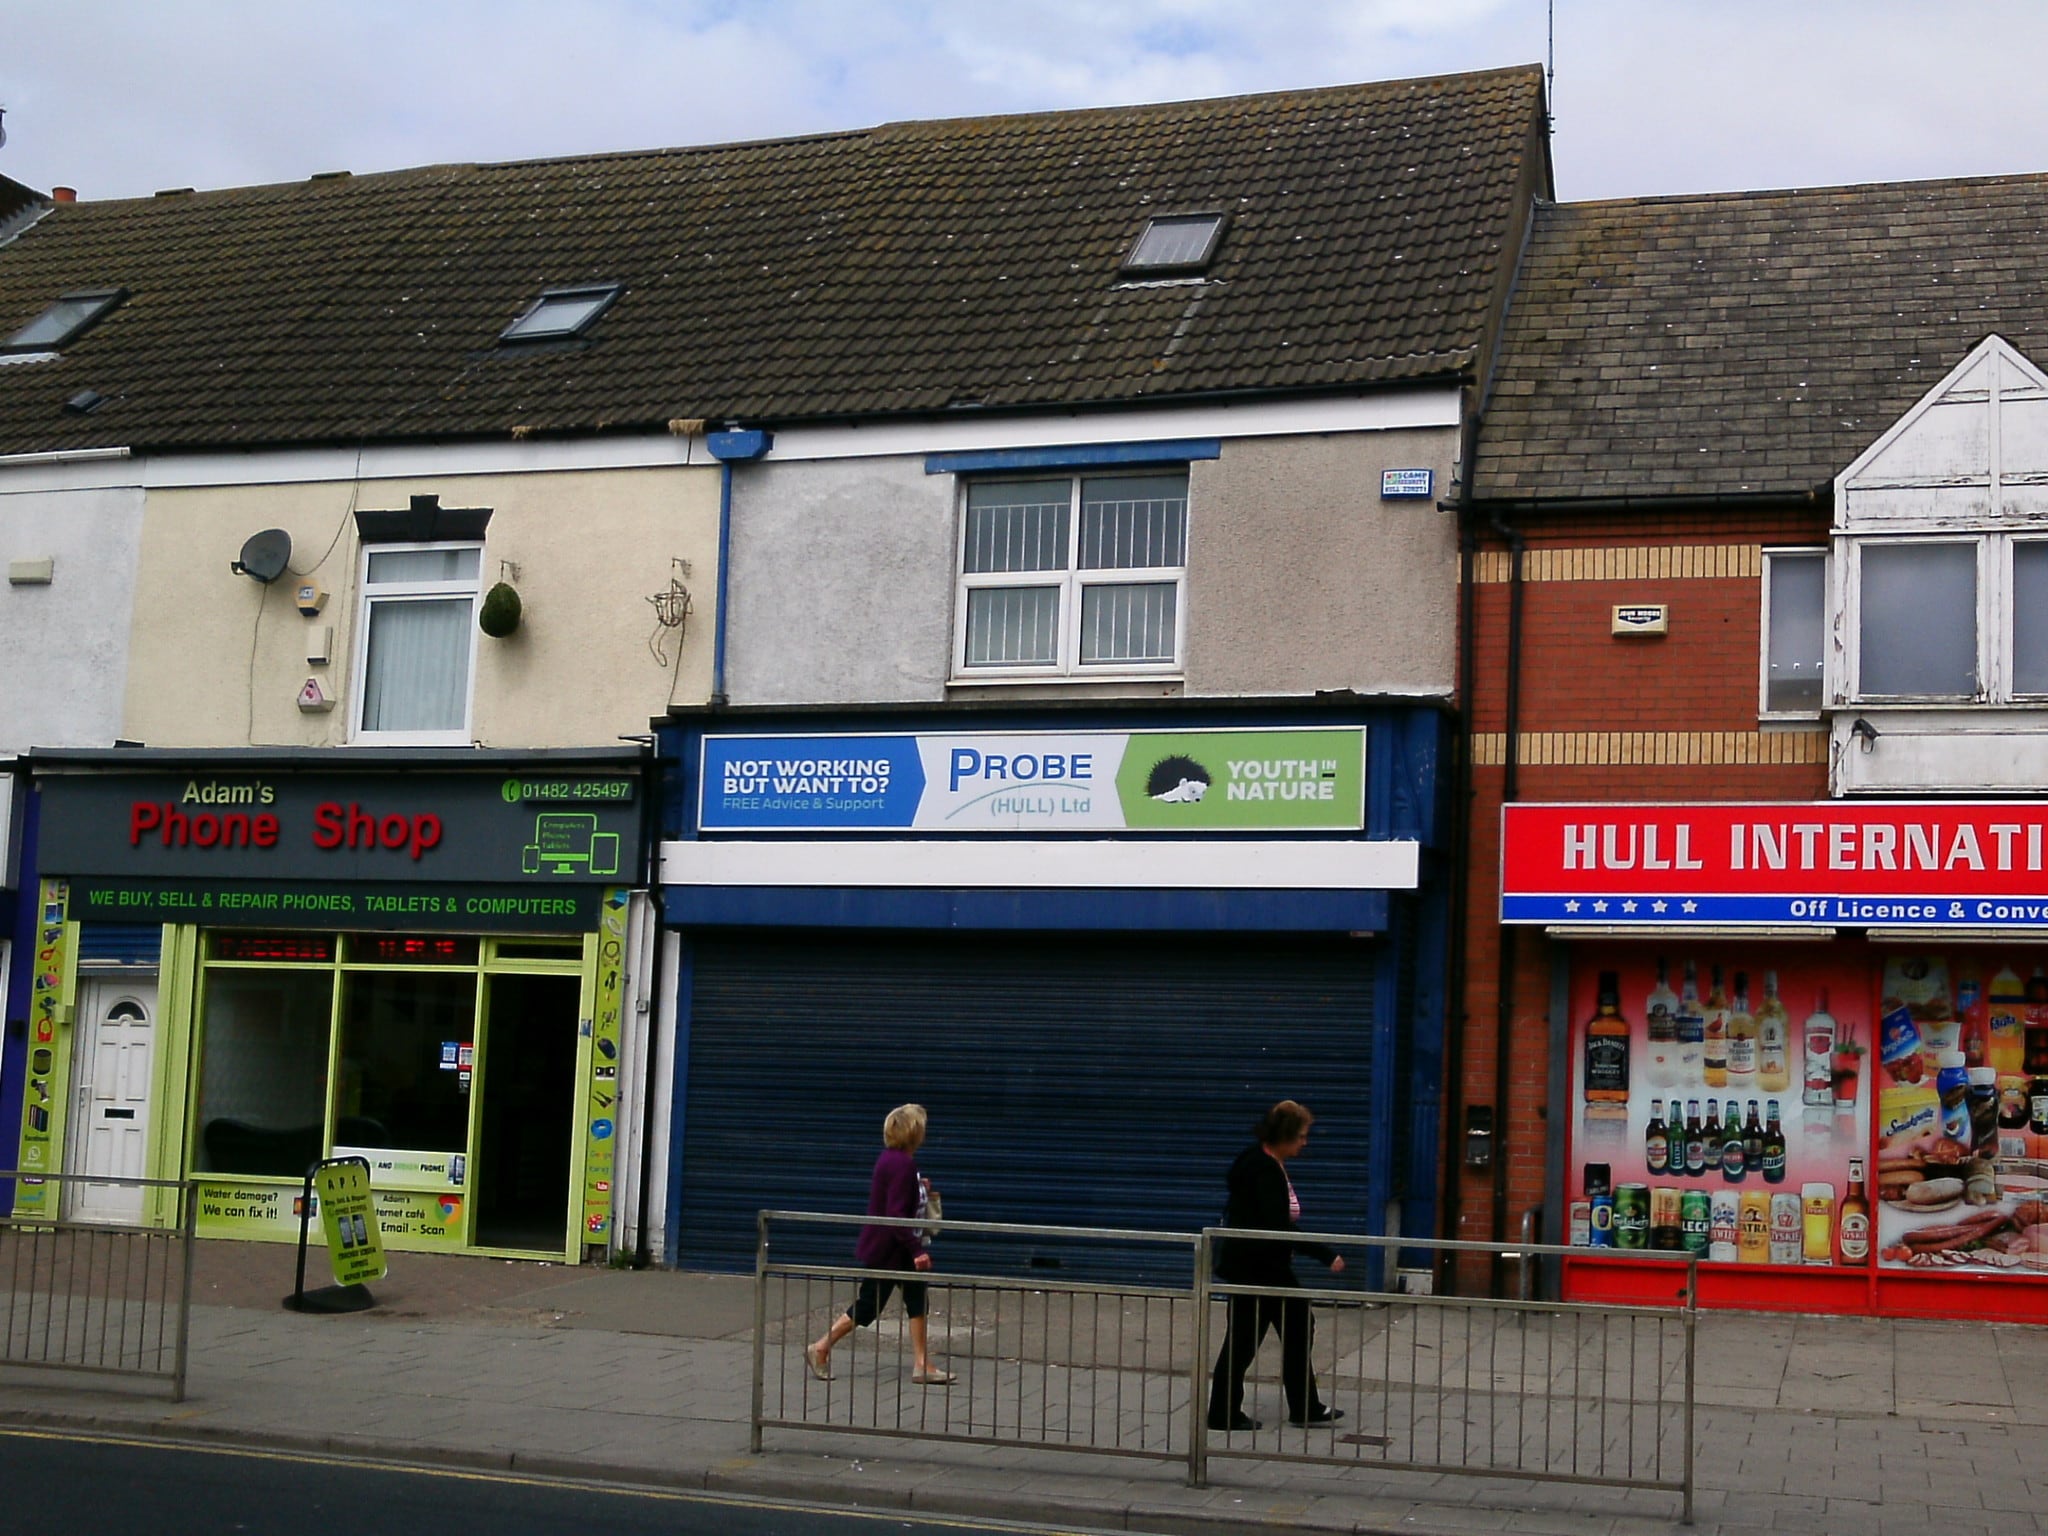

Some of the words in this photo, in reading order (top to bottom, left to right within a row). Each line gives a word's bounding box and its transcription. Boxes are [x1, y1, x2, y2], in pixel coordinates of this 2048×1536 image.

[724, 761, 772, 776] NOT
[776, 760, 890, 776] WORKING
[950, 748, 1092, 791] PROBE
[1227, 760, 1317, 779] YOUTH
[1322, 760, 1336, 770] IN
[182, 781, 274, 804] Adam's
[523, 783, 569, 798] 01482
[573, 783, 629, 798] 425497
[723, 778, 769, 794] BUT
[773, 778, 843, 793] WANT
[848, 777, 889, 793] TO?
[1227, 781, 1334, 800] NATURE
[723, 798, 759, 809] FREE
[763, 798, 809, 809] Advice
[812, 798, 822, 809] &
[826, 797, 884, 811] Support
[991, 798, 1055, 816] (HULL)
[1061, 798, 1090, 813] Ltd
[130, 802, 279, 846] Phone
[312, 802, 442, 860] Shop
[1563, 823, 1703, 871] HULL
[1730, 823, 2044, 872] INTERNATI
[90, 890, 114, 905] WE
[119, 891, 153, 907] BUY,
[159, 892, 197, 907] SELL
[202, 893, 212, 907] &
[219, 893, 278, 909] REPAIR
[283, 895, 355, 912] PHONES,
[365, 896, 440, 912] TABLETS
[446, 897, 457, 912] &
[466, 898, 577, 915] COMPUTERS
[1790, 900, 1827, 917] Off
[1837, 901, 1937, 918] Licence
[1948, 902, 1965, 918] &
[203, 1188, 231, 1199] Water
[234, 1190, 278, 1203] damage?
[383, 1195, 410, 1204] Adam's
[203, 1204, 221, 1215] We
[225, 1207, 245, 1217] can
[249, 1206, 263, 1218] fix
[266, 1207, 278, 1219] it!
[376, 1208, 403, 1218] ternet
[381, 1222, 409, 1233] Email
[420, 1224, 445, 1235] Scan
[1682, 1220, 1709, 1232] LECH
